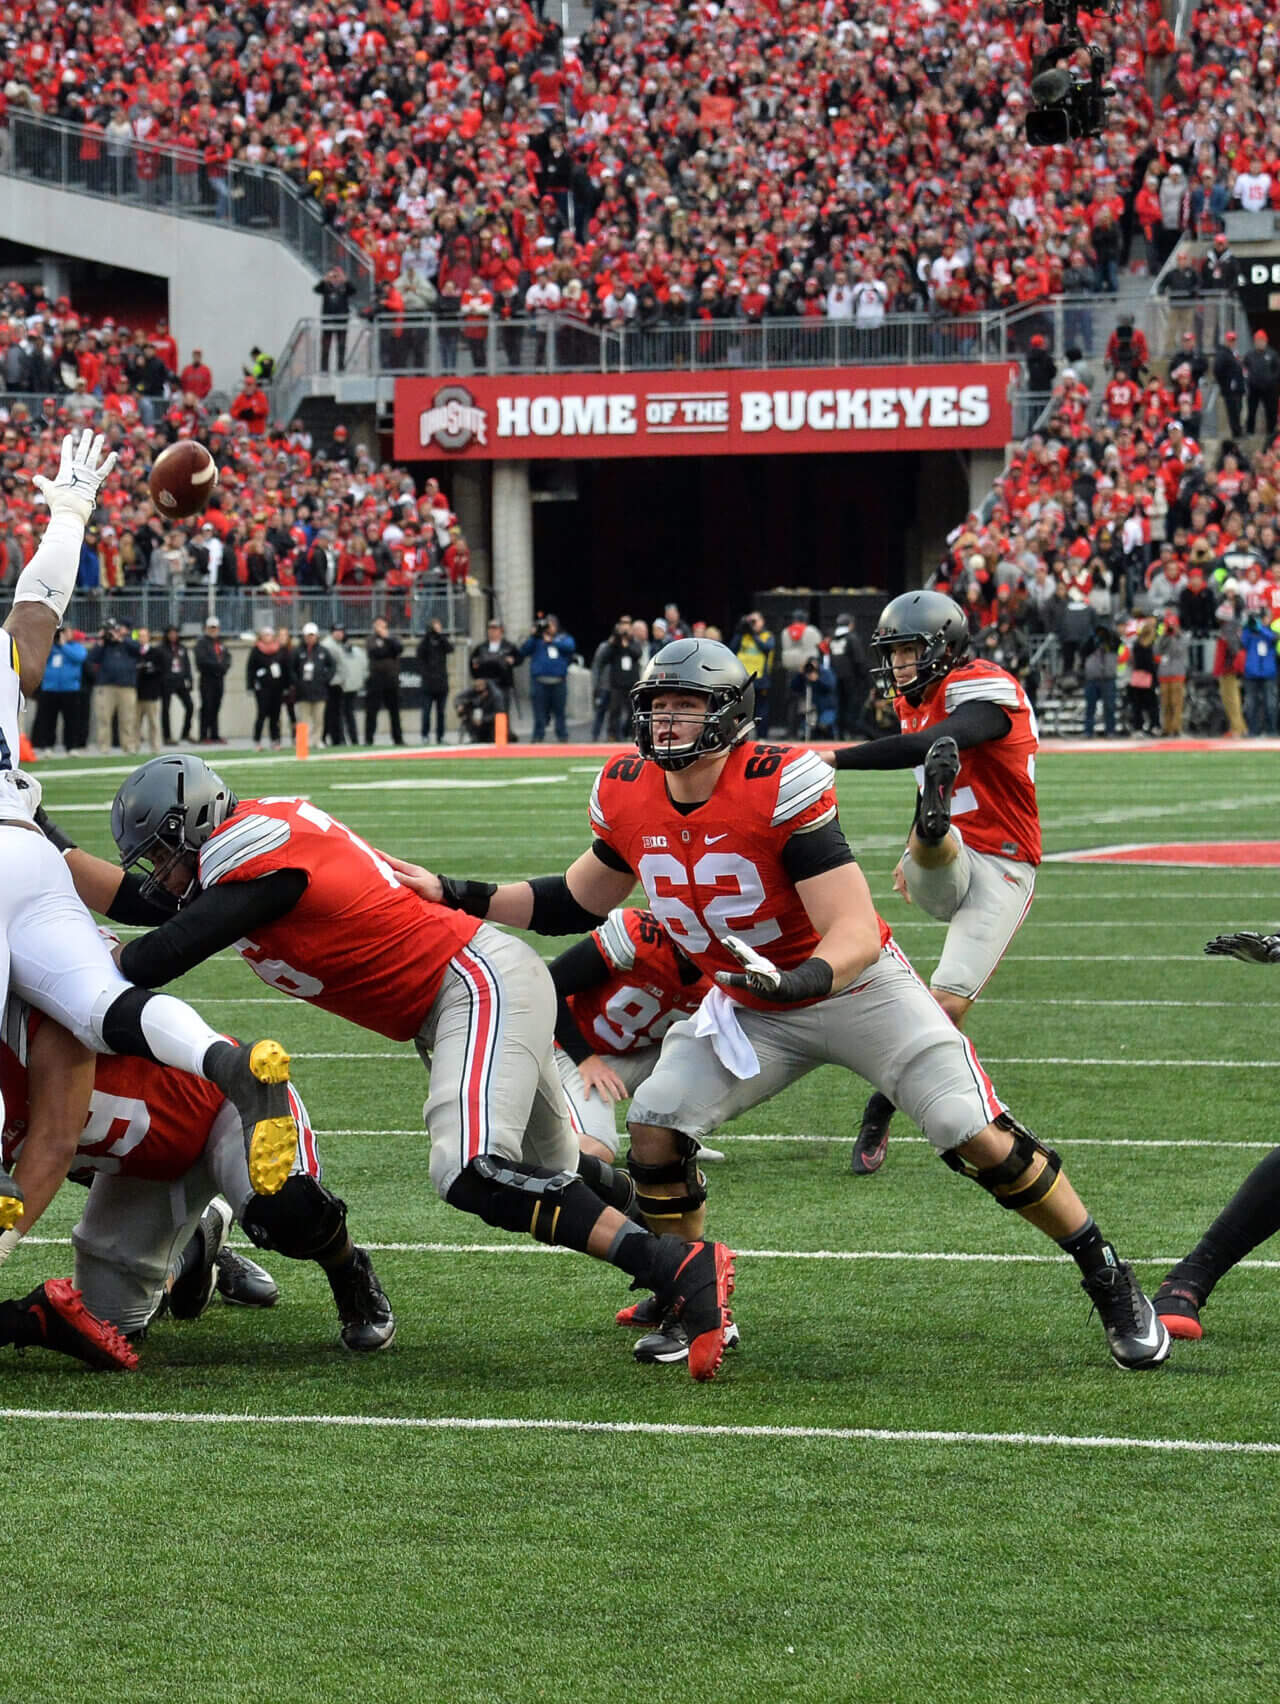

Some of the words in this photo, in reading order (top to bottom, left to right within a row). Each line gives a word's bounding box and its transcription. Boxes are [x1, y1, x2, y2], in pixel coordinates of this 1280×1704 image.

[497, 395, 637, 436] HOME
[646, 403, 676, 425] OF
[681, 400, 728, 423] THE
[740, 386, 991, 430] BUCKEYES
[642, 835, 668, 848] BIG
[638, 853, 783, 954] 62
